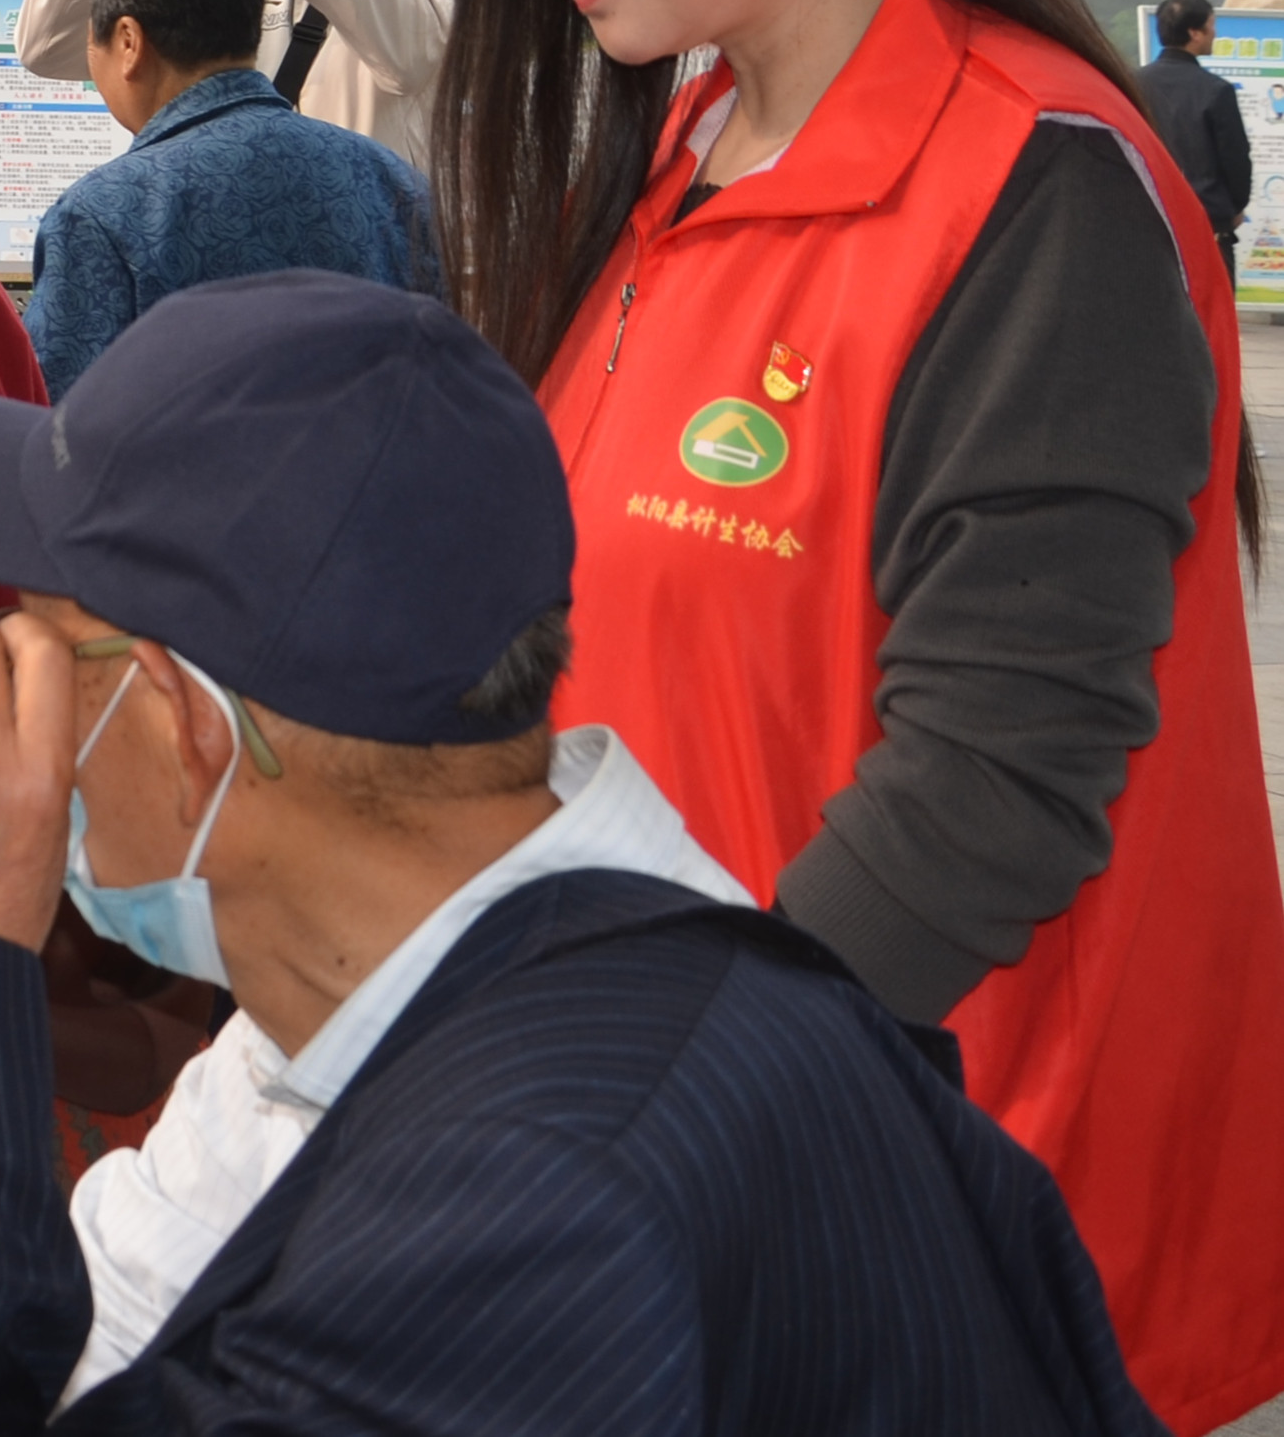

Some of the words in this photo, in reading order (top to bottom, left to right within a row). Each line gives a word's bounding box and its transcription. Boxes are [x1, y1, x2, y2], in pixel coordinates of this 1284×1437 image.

[627, 492, 803, 559] 枞阳县计生协会
